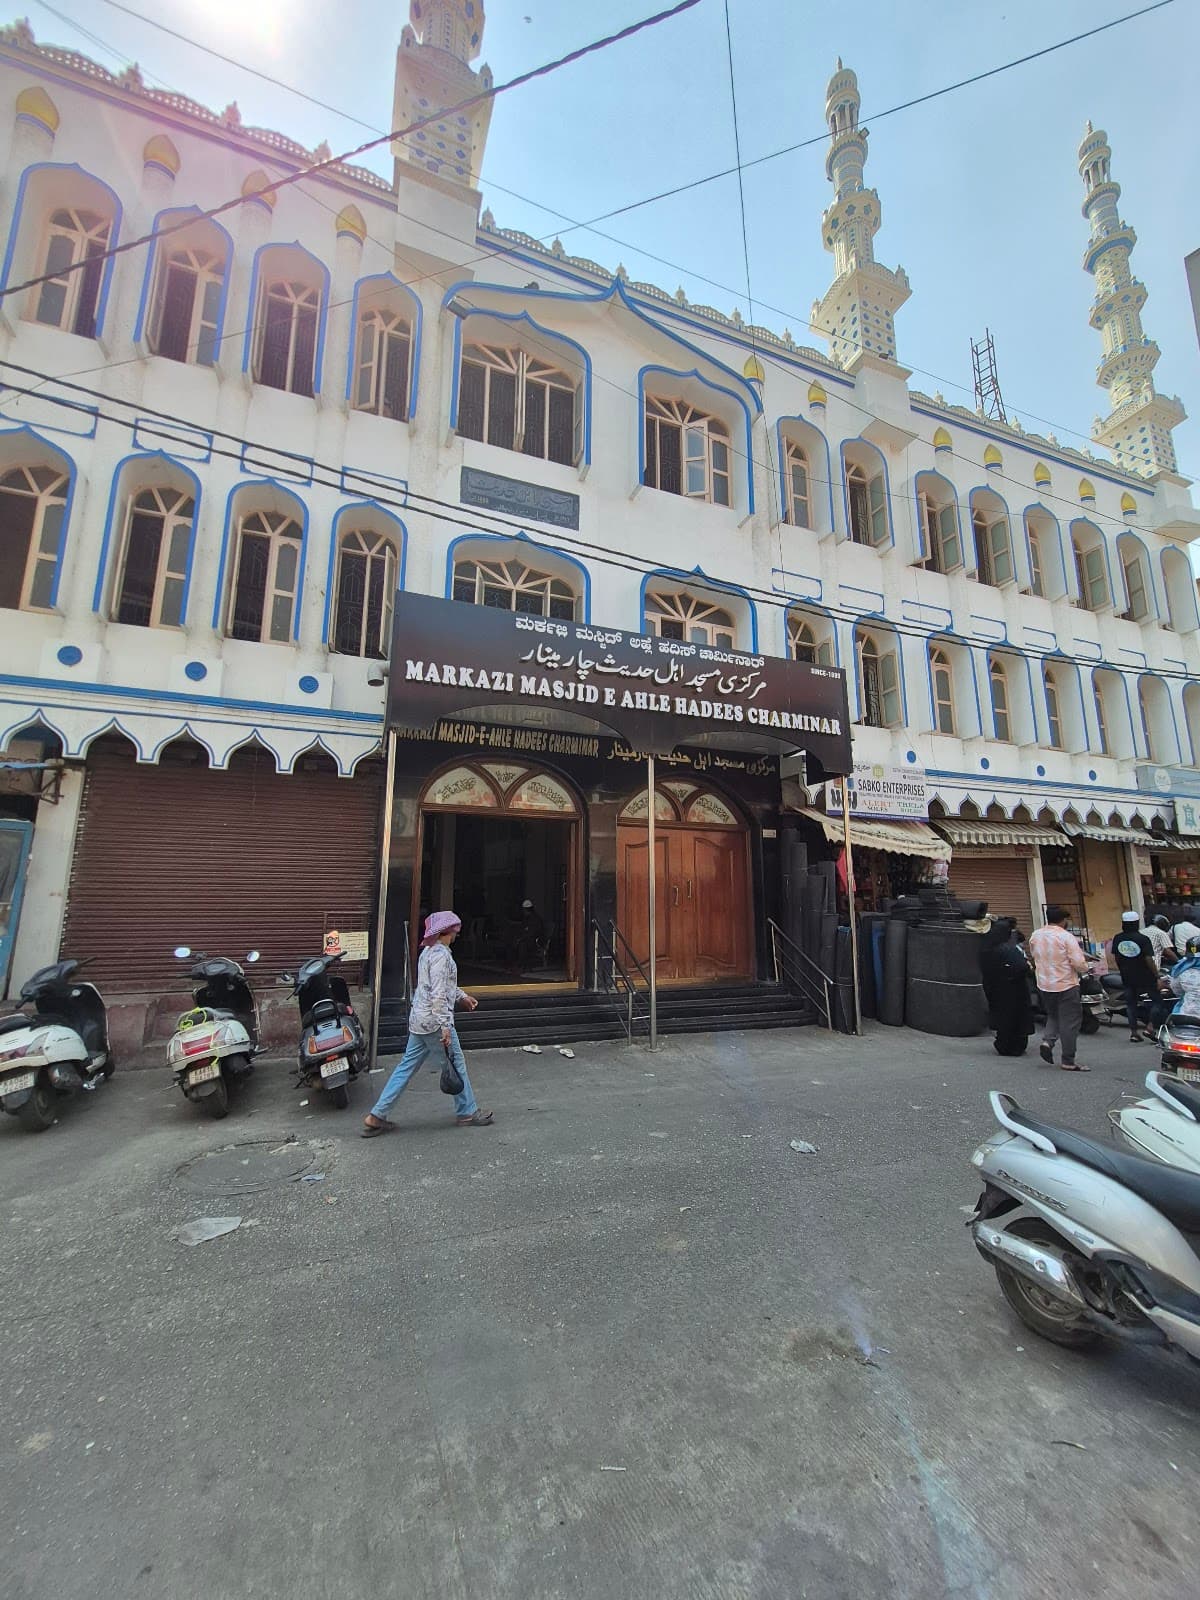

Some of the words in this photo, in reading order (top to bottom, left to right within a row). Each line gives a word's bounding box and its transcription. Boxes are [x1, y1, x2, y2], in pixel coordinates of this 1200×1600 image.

[595, 653, 655, 678] حدیث
[684, 668, 722, 693] مسجد
[717, 671, 767, 700] مرکزی
[405, 659, 514, 692] MARKAZI
[520, 675, 599, 704] MASJID
[603, 687, 616, 706] E
[620, 690, 671, 713] AHLE
[675, 696, 744, 722] HADEES
[747, 707, 842, 736] CHARMINAR
[513, 730, 548, 752] HADEES
[548, 734, 599, 758] CHARMINAR
[714, 757, 745, 770] مسجد
[858, 778, 881, 793] SABKO
[883, 781, 925, 797] ENTERPRISES
